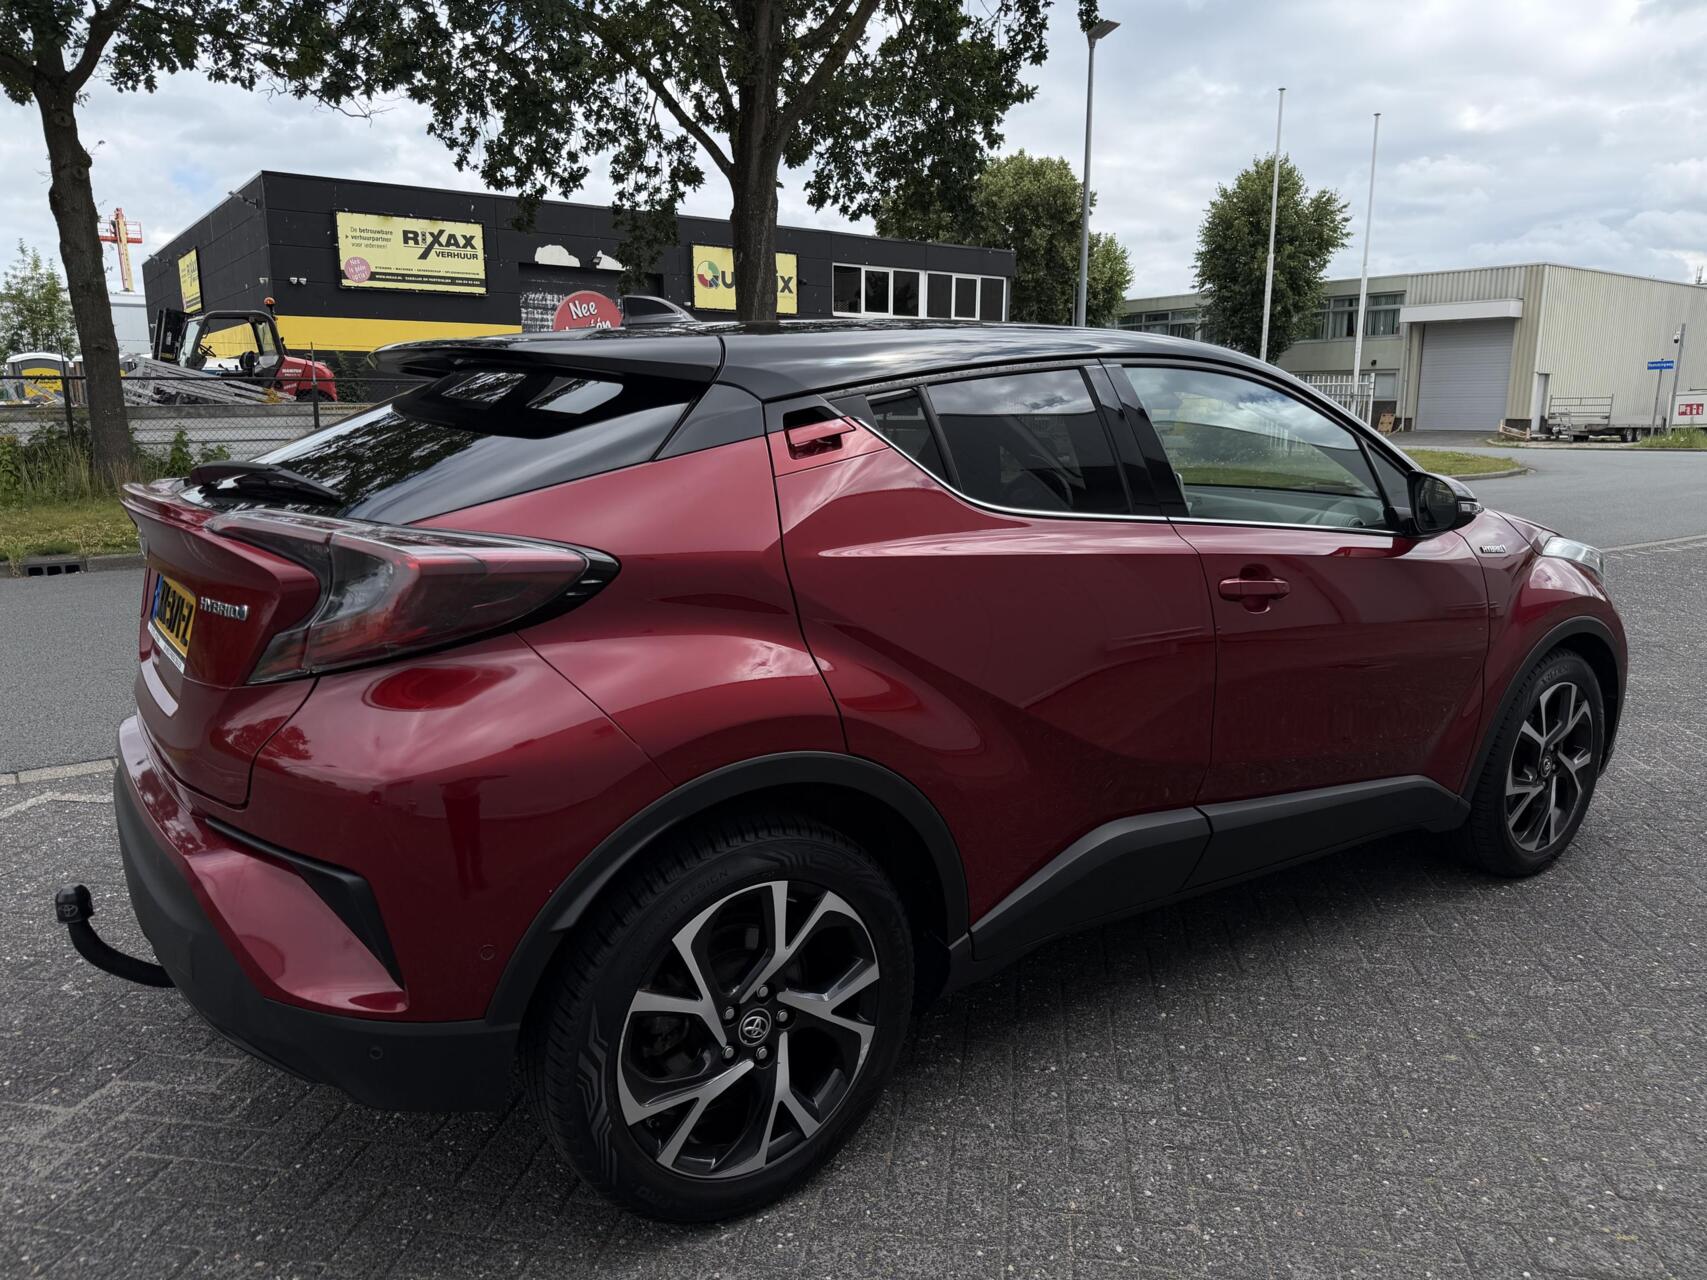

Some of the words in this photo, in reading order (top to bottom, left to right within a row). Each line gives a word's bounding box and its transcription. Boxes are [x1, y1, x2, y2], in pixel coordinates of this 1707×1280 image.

[359, 228, 393, 236] betrouwbare
[351, 235, 392, 243] verhuurpartner
[435, 250, 479, 260] VERHUUR
[568, 300, 598, 320] Nee
[200, 596, 240, 619] HYBRID
